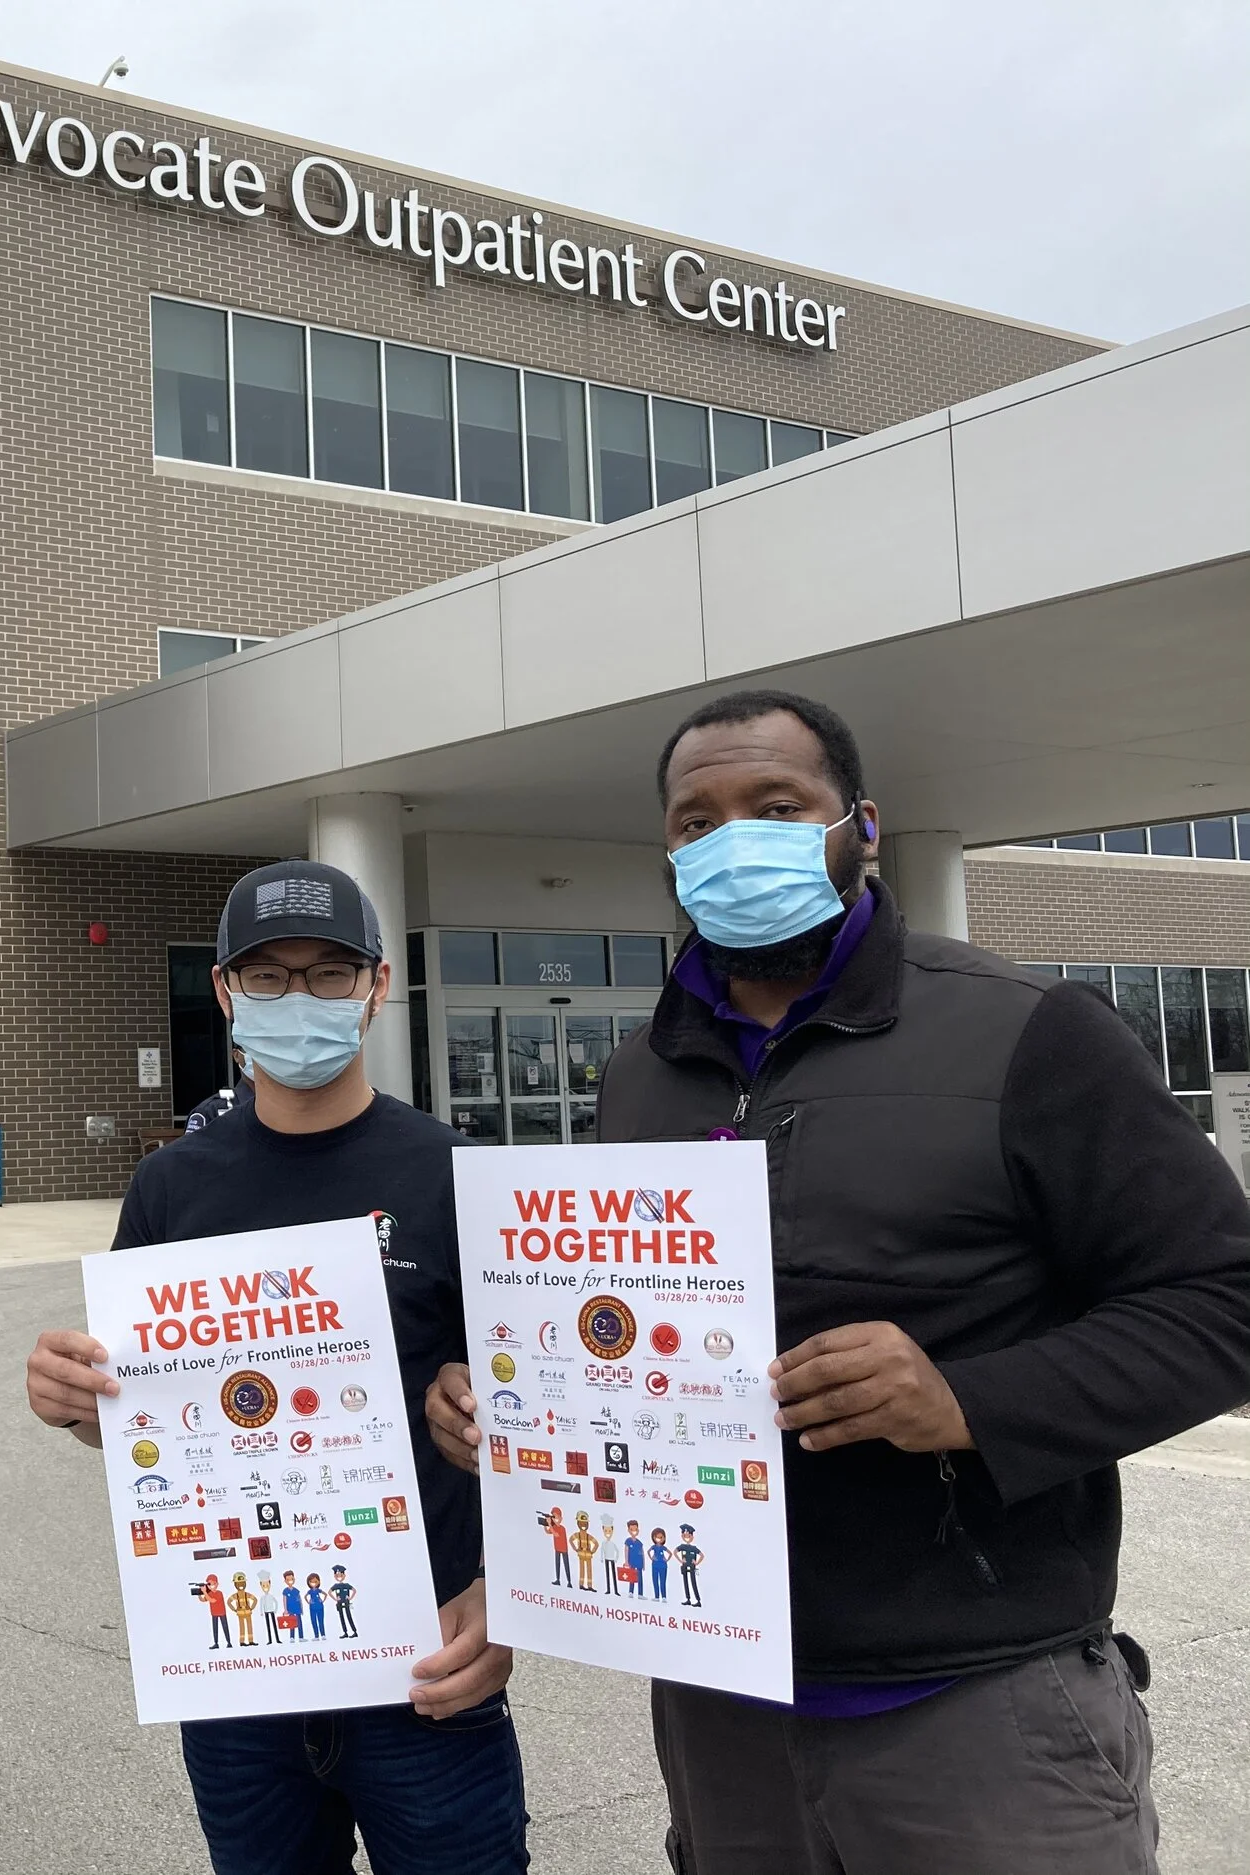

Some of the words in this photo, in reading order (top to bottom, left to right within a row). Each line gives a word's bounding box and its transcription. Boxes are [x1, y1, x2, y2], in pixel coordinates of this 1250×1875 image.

[290, 155, 648, 308] Outpatient
[661, 249, 846, 352] Center
[538, 962, 572, 983] 2535
[513, 1189, 577, 1223] WE
[499, 1227, 719, 1265] TOGETHER
[383, 1258, 417, 1270] chuan
[482, 1270, 522, 1286] Meals
[526, 1270, 541, 1286] of
[544, 1272, 576, 1288] Love
[575, 1268, 606, 1294] for
[610, 1274, 681, 1290] Frontline
[687, 1276, 745, 1292] Heroes
[146, 1279, 210, 1316] WE
[654, 1292, 698, 1304] 03/28/20
[705, 1293, 745, 1304] 4/30/20
[133, 1300, 344, 1353] TOGETHER
[116, 1361, 160, 1379] Meals
[163, 1358, 179, 1373] of
[182, 1355, 216, 1371] Love
[215, 1348, 243, 1375] for
[247, 1343, 314, 1365] Frontline
[317, 1338, 371, 1356] Heroes
[290, 1356, 330, 1370] 03/28/20
[336, 1352, 371, 1365] 4/30/20
[493, 1414, 533, 1428] Bonchon
[701, 1469, 731, 1481] junzi
[137, 1497, 182, 1510] Bonchon
[347, 1510, 374, 1524] junzi
[510, 1588, 548, 1609] POLICE,
[550, 1597, 603, 1620] FIREMAN,
[606, 1607, 665, 1629] HOSPITAL
[668, 1616, 679, 1630] &
[682, 1618, 721, 1636] NEWS
[724, 1625, 762, 1643] STAFF
[161, 1661, 206, 1676] POLICE,
[208, 1656, 267, 1673] FIREMAN,
[269, 1652, 324, 1668] HOSPITAL
[328, 1651, 339, 1662] &
[342, 1648, 378, 1662] NEWS
[381, 1644, 416, 1659] STAFF
